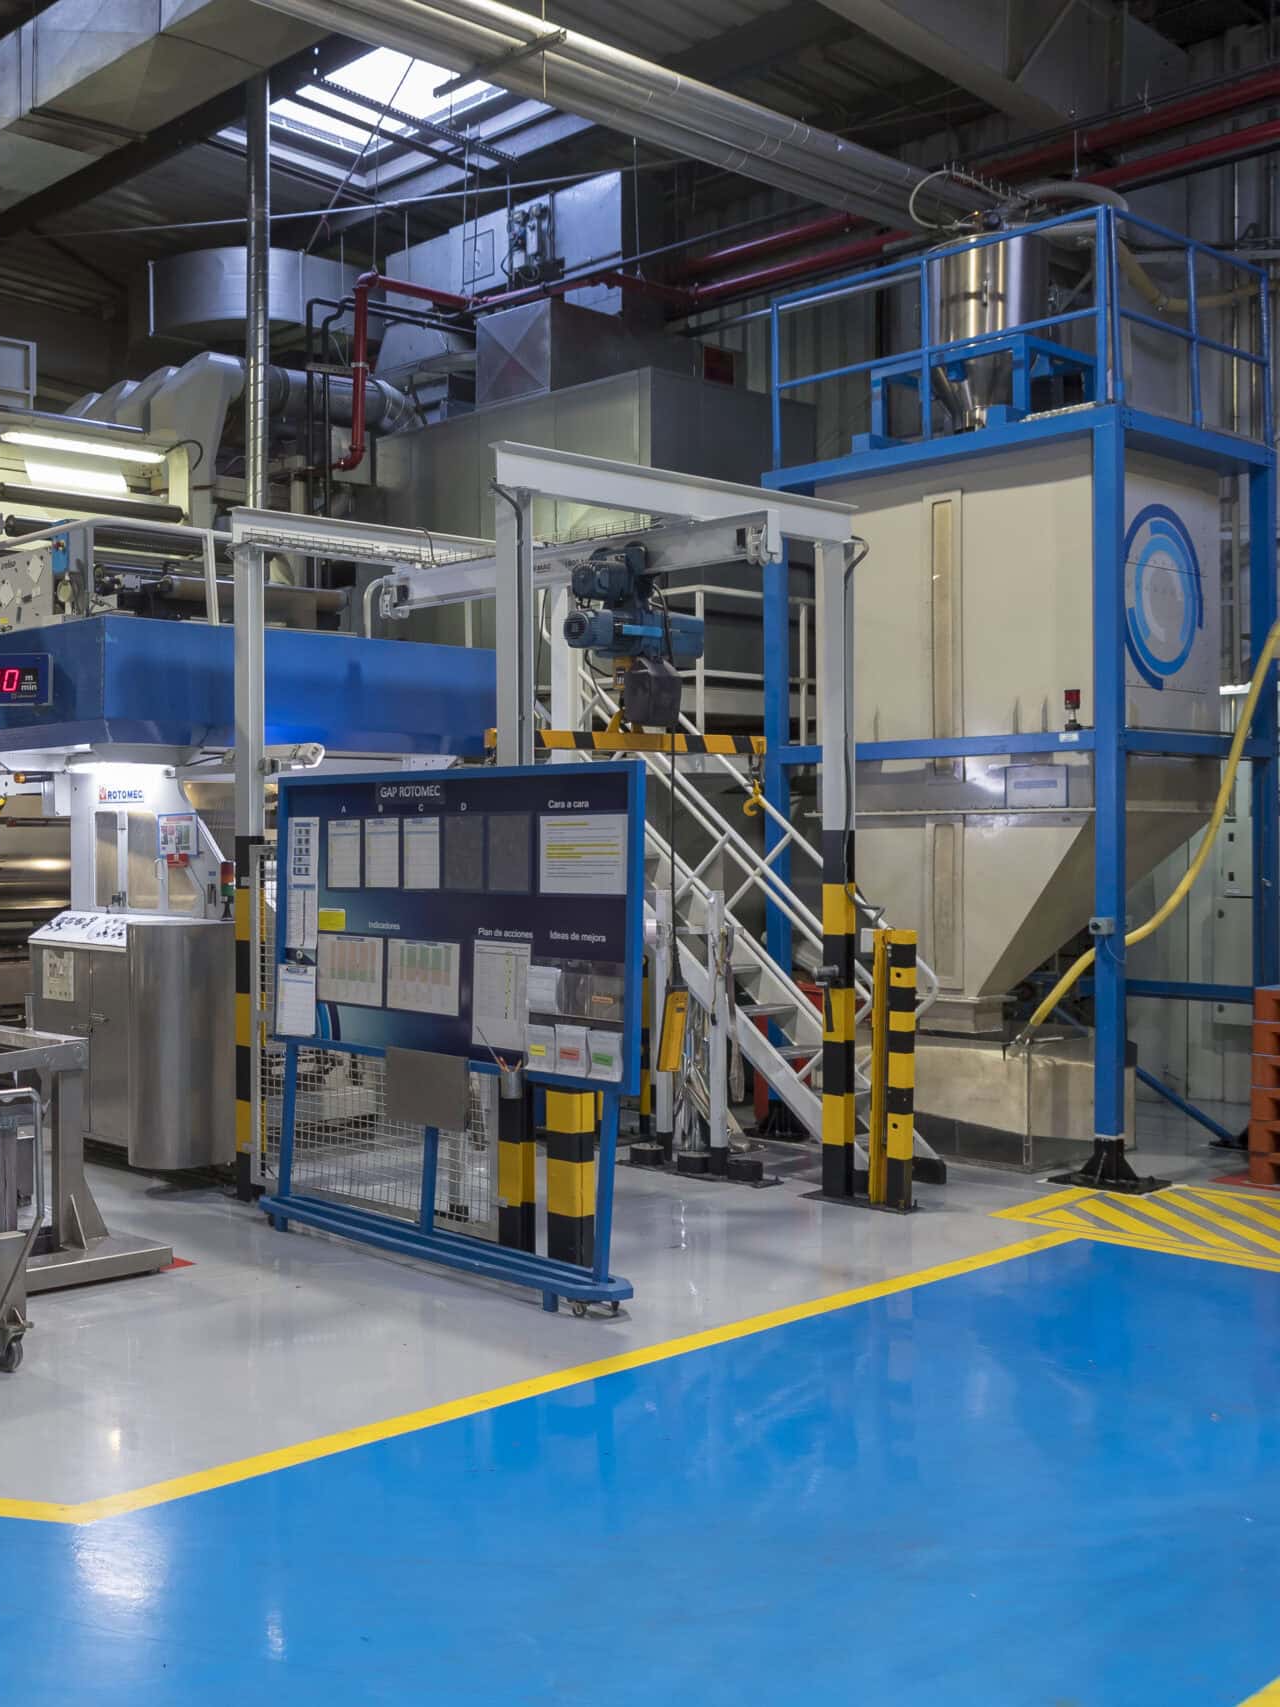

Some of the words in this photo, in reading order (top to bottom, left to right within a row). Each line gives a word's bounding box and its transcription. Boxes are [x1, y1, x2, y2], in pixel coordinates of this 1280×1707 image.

[21, 683, 37, 691] min
[107, 790, 143, 800] ROTOMEC
[380, 786, 397, 798] GAP
[399, 785, 441, 797] ROTOMEC
[417, 803, 424, 812] C
[460, 802, 467, 811] D
[547, 799, 565, 808] Cara
[573, 800, 590, 808] cara
[478, 928, 493, 936] Plan
[494, 928, 502, 937] de
[503, 929, 533, 939] acciones
[550, 930, 569, 940] Ideas
[570, 931, 579, 940] de
[581, 932, 606, 944] mejora
